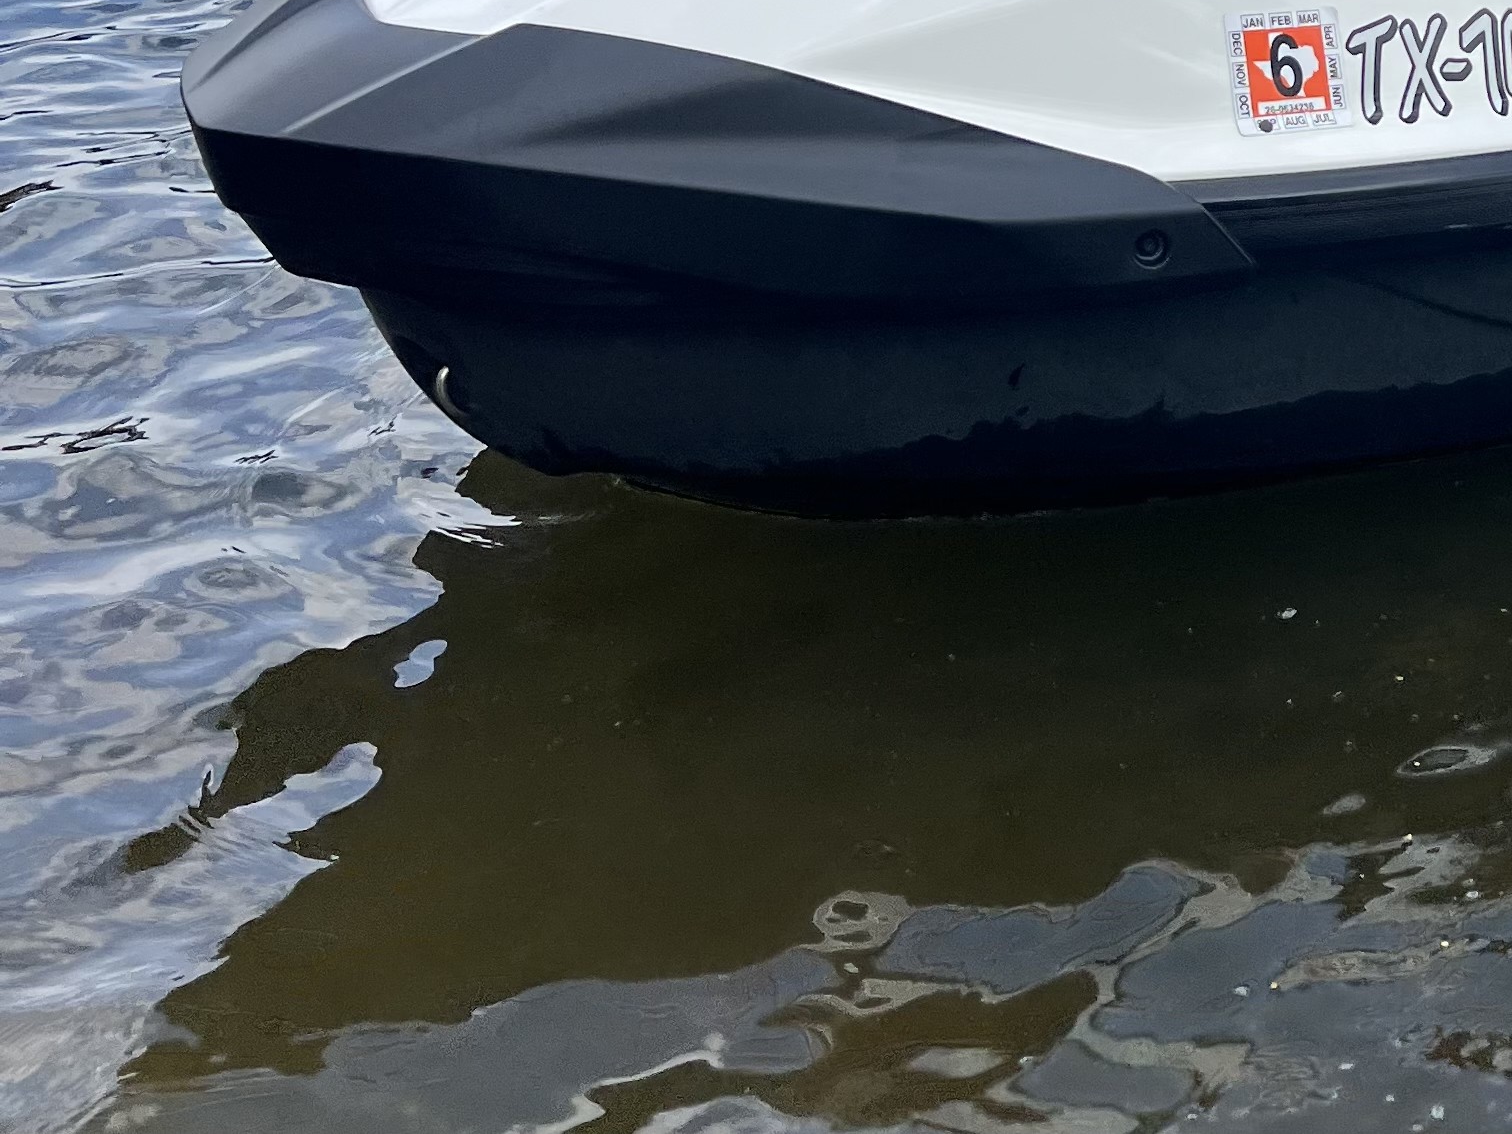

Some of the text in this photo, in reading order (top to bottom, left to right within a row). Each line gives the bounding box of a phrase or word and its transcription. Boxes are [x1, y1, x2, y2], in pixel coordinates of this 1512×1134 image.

[1243, 13, 1319, 28] JAN FEB MAR
[1231, 33, 1242, 55] DEC
[1324, 26, 1334, 47] APR
[1235, 63, 1246, 86] NOV
[1270, 34, 1303, 97] 6
[1328, 57, 1338, 78] MAY
[1239, 95, 1250, 116] OCT
[1332, 86, 1342, 107] JUN
[1285, 116, 1306, 126] AUG
[1314, 113, 1333, 123] JUL
